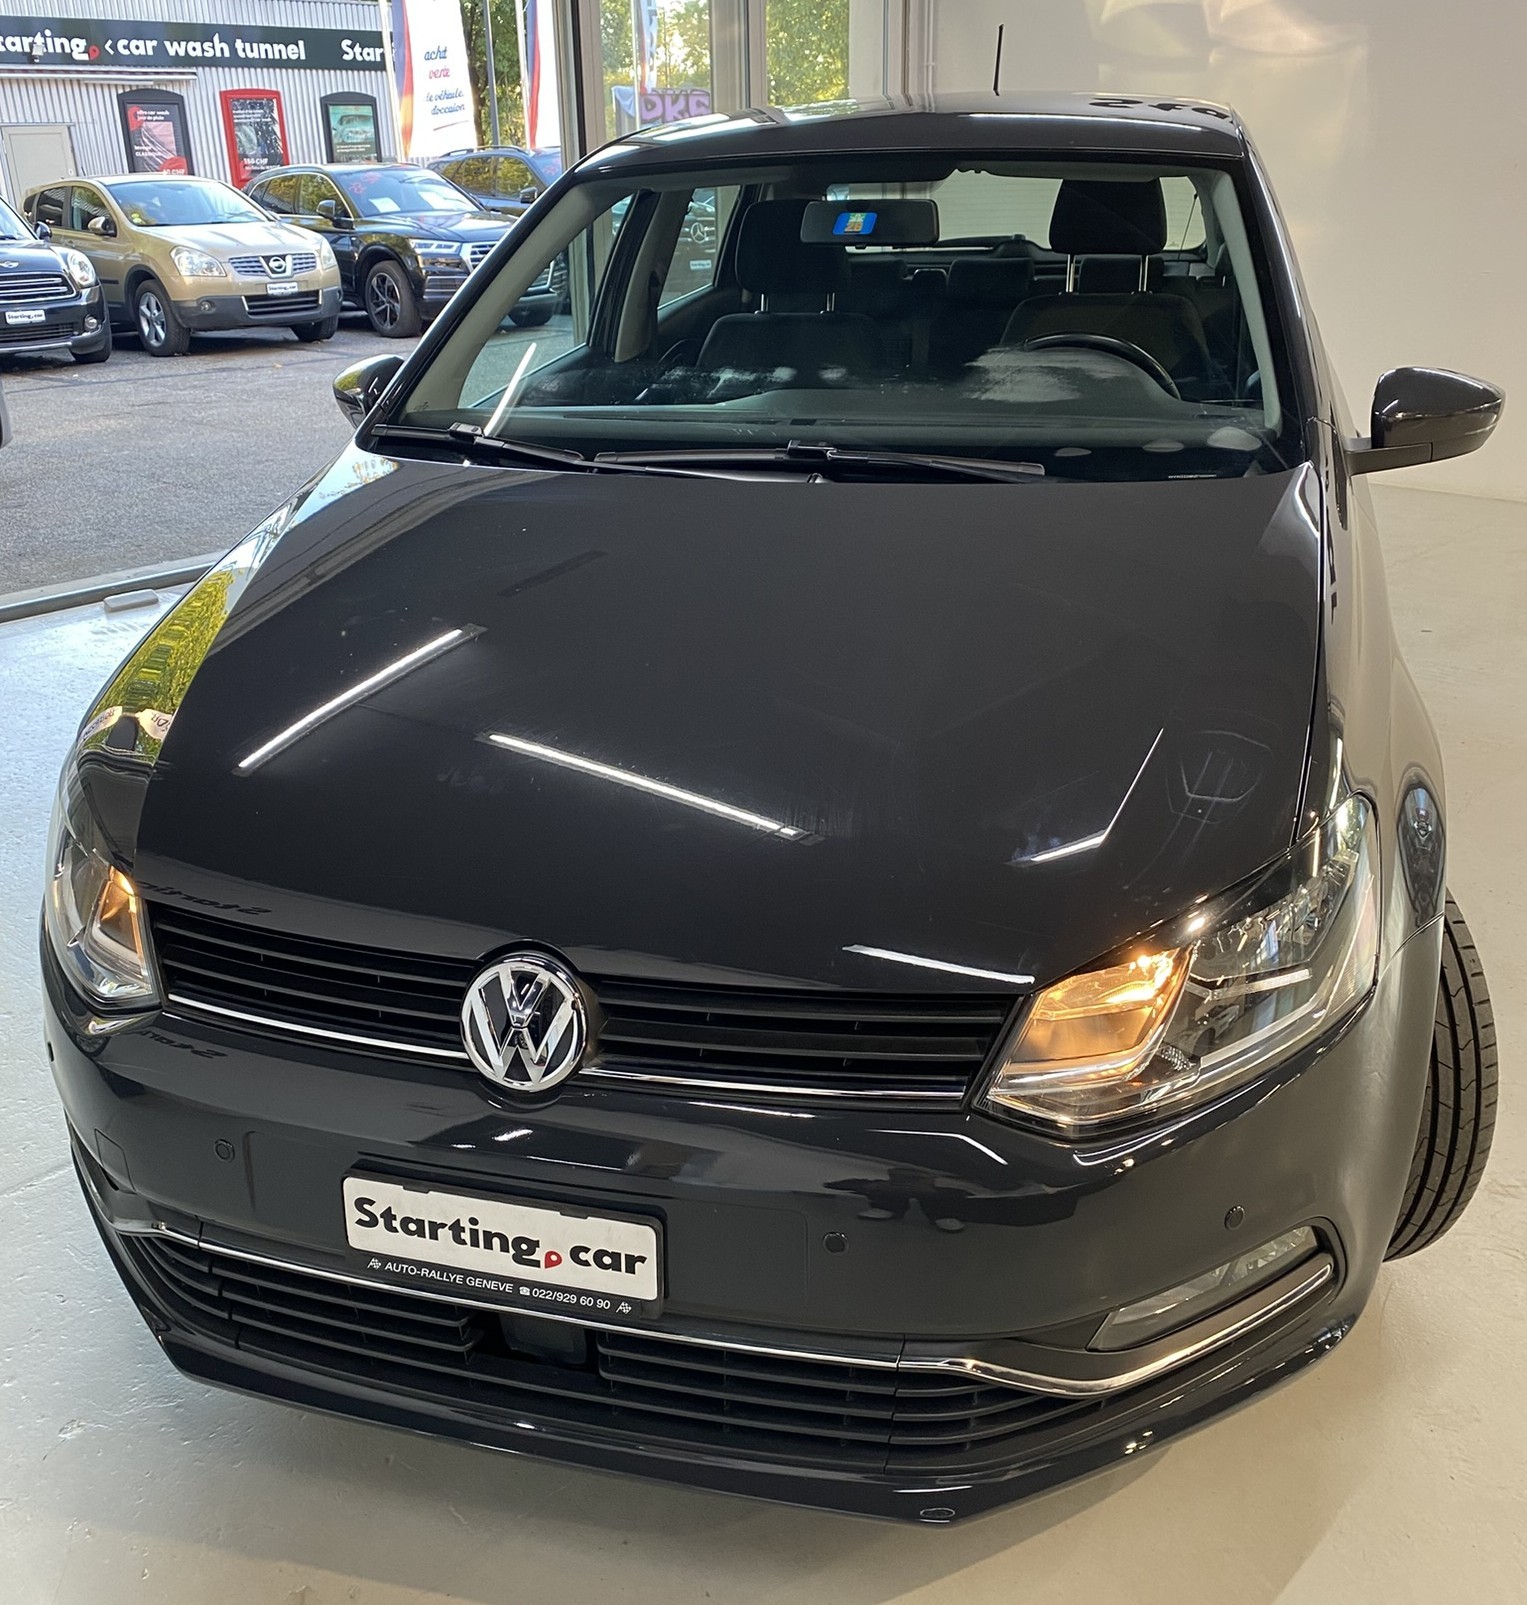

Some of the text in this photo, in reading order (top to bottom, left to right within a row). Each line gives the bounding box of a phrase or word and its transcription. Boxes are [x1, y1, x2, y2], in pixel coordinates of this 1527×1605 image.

[117, 38, 157, 56] car
[163, 33, 230, 58] wash
[235, 38, 306, 60] tunnel
[353, 1197, 647, 1275] Starting car
[384, 1262, 611, 1310] AUTO-RALLYE GENEVE 022/929 60 90
